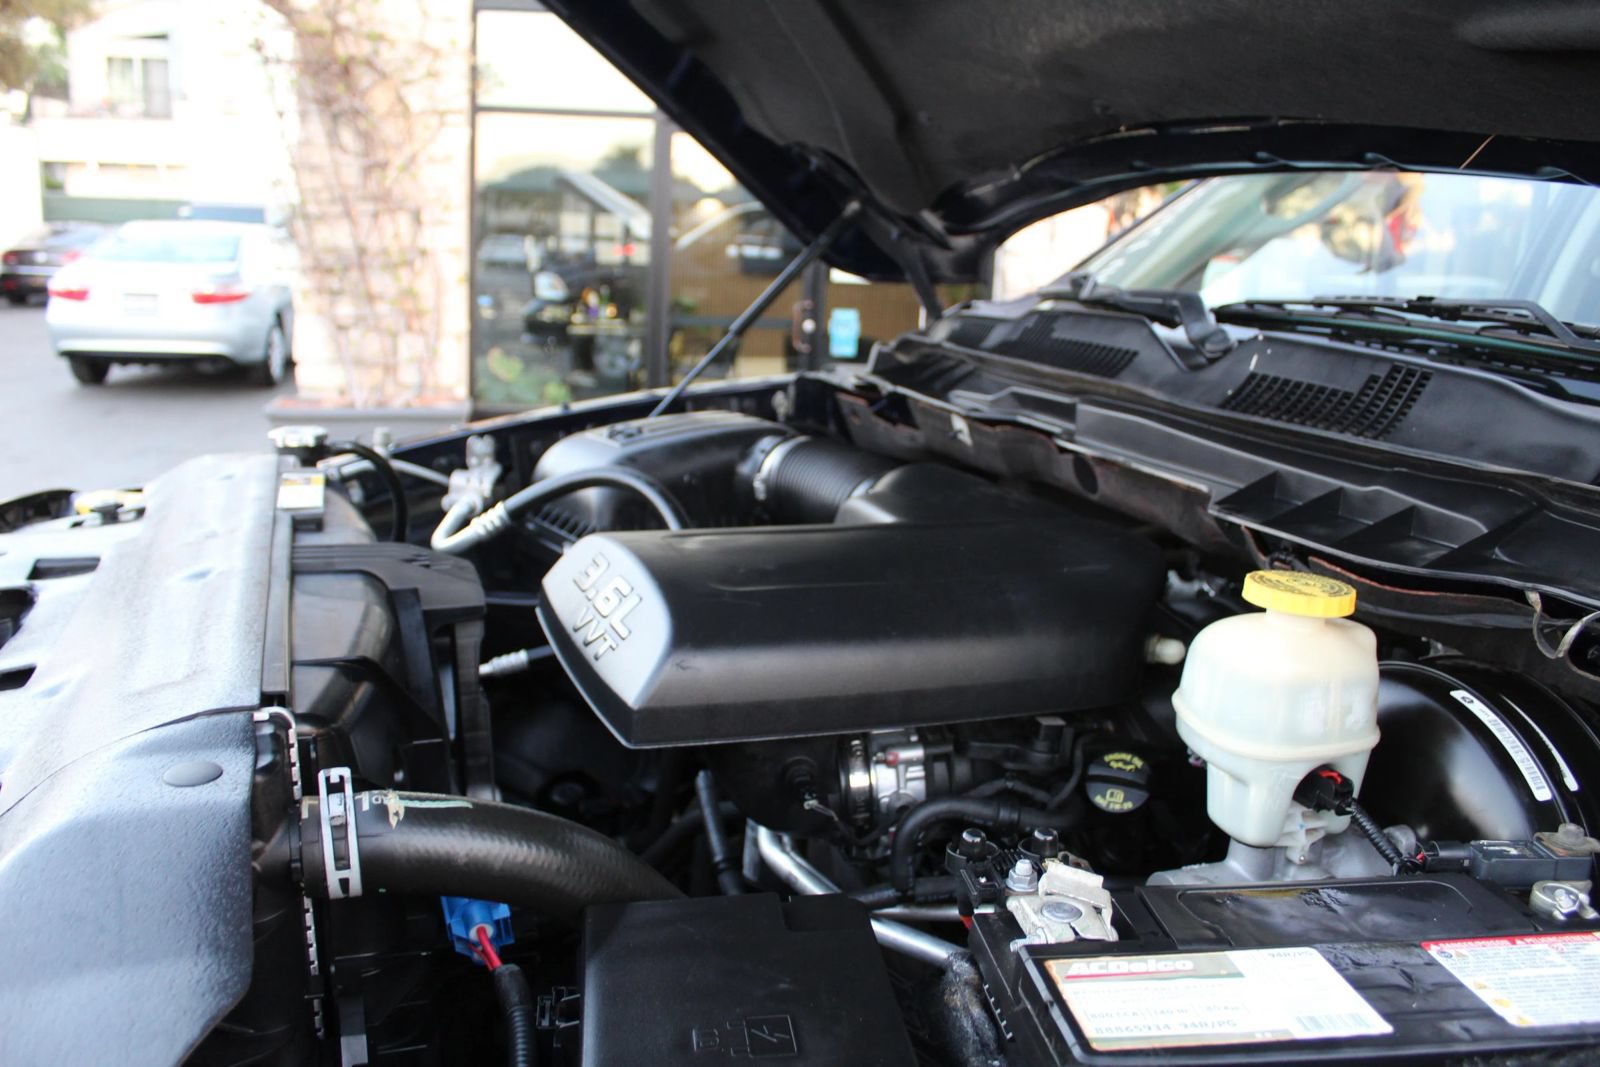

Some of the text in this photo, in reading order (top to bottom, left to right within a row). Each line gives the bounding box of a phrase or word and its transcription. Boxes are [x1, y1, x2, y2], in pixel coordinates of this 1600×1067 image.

[573, 552, 643, 640] 3.6L
[572, 607, 619, 661] VVT
[1067, 958, 1194, 975] ACDelco
